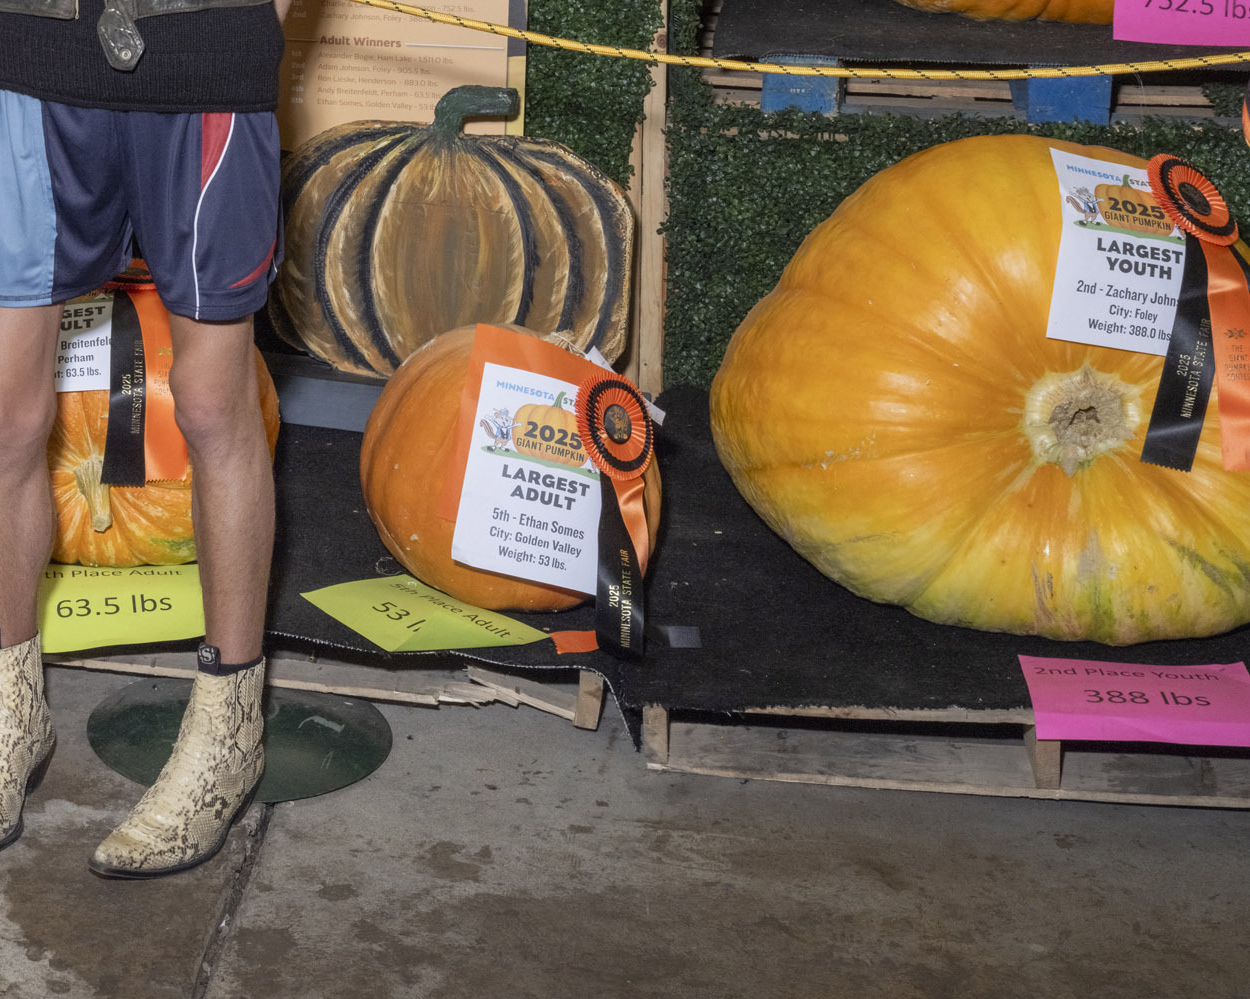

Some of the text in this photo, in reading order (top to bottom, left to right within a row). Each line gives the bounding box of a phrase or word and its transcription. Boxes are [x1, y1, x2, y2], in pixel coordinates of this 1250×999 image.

[319, 35, 402, 48] Adult Winners
[317, 63, 339, 71] Adam
[1066, 164, 1122, 182] MINNESOTA
[1104, 210, 1171, 231] GIANT PUMPKIN
[1108, 197, 1165, 220] 2025
[1097, 237, 1183, 264] LARGEST
[1106, 256, 1172, 280] YOUTH
[1076, 279, 1178, 308] 2nd Zachary John
[60, 318, 94, 331] ULT
[62, 306, 106, 319] GEST
[1109, 304, 1158, 326] City: Foley
[1088, 317, 1156, 339] Weight: 388.0
[58, 354, 94, 364] Perham
[1176, 353, 1191, 377] 2025
[1180, 318, 1211, 419] MINNESOTA STATE FAIR
[65, 367, 85, 378] 63.5
[86, 366, 102, 376] lbs.
[133, 359, 144, 384] STATE
[121, 373, 132, 395] 2025
[496, 380, 555, 401] MINNESOTA
[130, 387, 143, 434] MINNESOTA
[524, 421, 582, 450] 2025
[516, 437, 585, 462] GIANT PUMPKIN
[501, 464, 591, 497] LARGEST
[510, 484, 576, 511] ADULT
[492, 507, 585, 540] 5th Ethan Somes
[489, 525, 582, 558] City: Golden Valley
[498, 545, 567, 571] Weight: 53 lbs.
[45, 570, 64, 579] th
[71, 569, 123, 578] Place
[56, 593, 173, 618] 63.5 lbs
[608, 584, 620, 608] 2025
[619, 549, 632, 648] MINNESOTA STATE FAIR
[372, 601, 411, 621] 53
[419, 594, 463, 614] Place
[462, 613, 511, 639] Adult
[1033, 666, 1220, 681] 2nd Place Youth
[1084, 689, 1212, 707] 388 lbs
